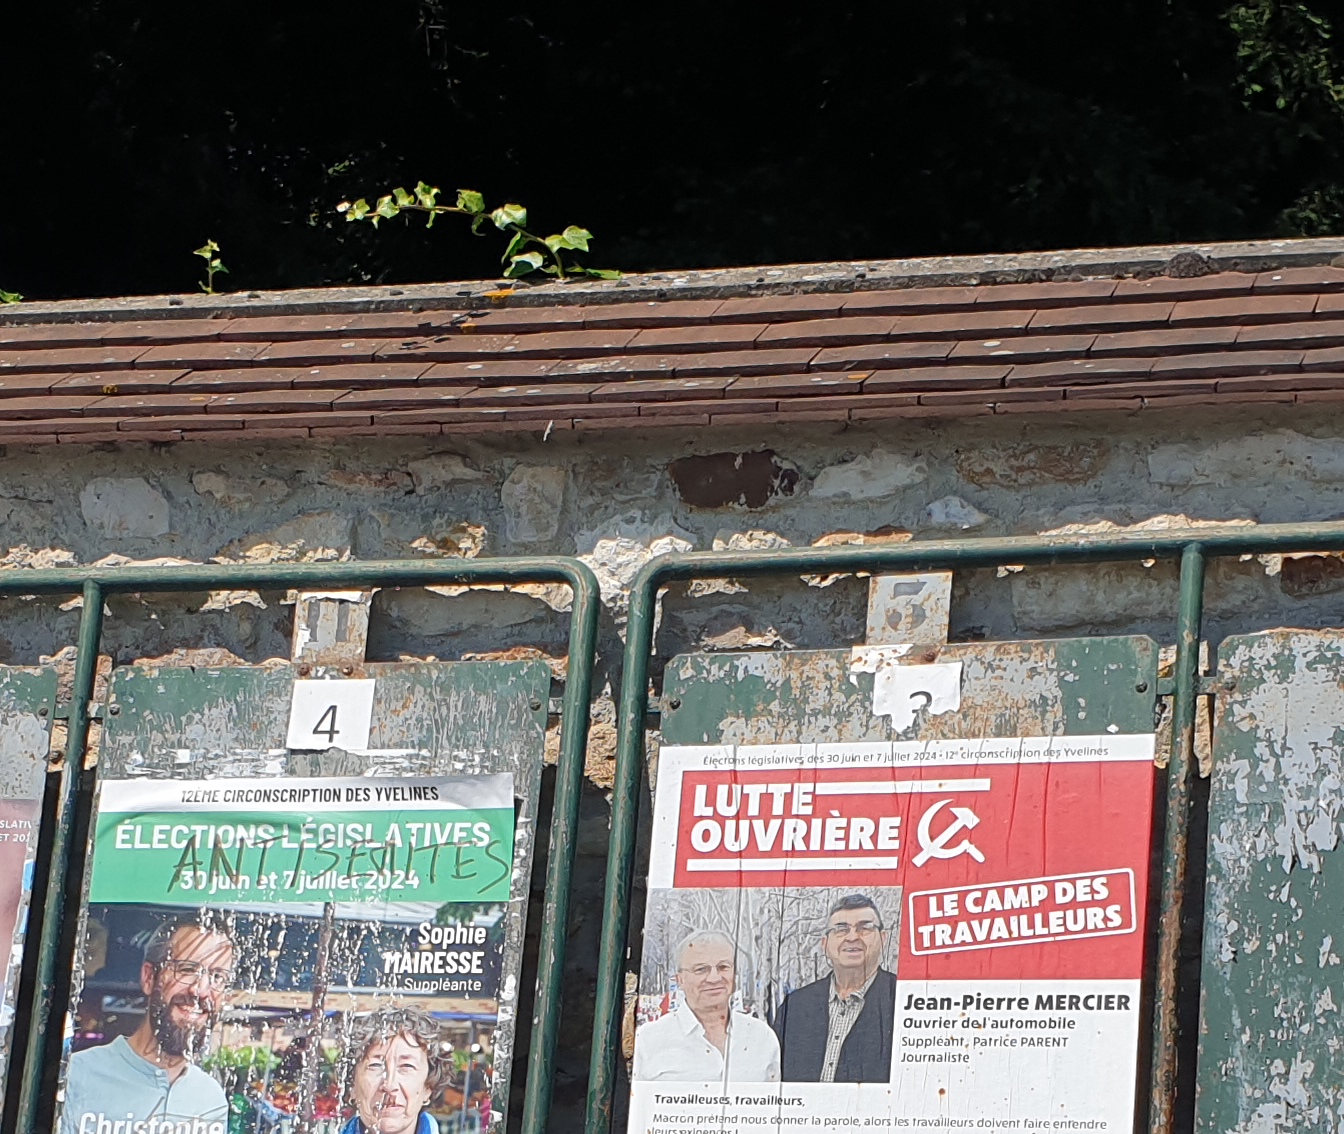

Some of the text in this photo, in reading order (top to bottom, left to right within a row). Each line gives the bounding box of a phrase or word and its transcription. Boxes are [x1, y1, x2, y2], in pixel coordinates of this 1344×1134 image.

[313, 704, 340, 743] 4
[913, 747, 1109, 761] 2024 circonscription Yvelines
[224, 786, 439, 803] CIRCONSCRIPTION DES YVELINES
[693, 783, 815, 817] LUTTE
[115, 817, 491, 849] ÉLECTIONS LÉGISLATIVES
[690, 810, 902, 852] OUVRIÈRE
[363, 869, 420, 890] 2024
[929, 877, 1109, 918] LE CAMP DES
[418, 922, 486, 949] Sophie
[918, 904, 1123, 948] TRAVAILLEURS
[384, 952, 484, 975] MAIRESSE
[404, 977, 482, 992] Suppléante
[904, 992, 1131, 1011] Jean-Pierre MERCIER
[903, 1017, 1076, 1029] Ouvrier l'automobile
[973, 1037, 1069, 1047] Patrice PARENT
[901, 1052, 970, 1063] Journaliste
[735, 1096, 805, 1107] travailleurs,
[653, 1114, 693, 1124] Macron
[741, 1116, 767, 1125] nous
[812, 1116, 821, 1126] la
[824, 1116, 862, 1130] parole,
[864, 1117, 891, 1127] alors
[894, 1117, 909, 1127] les
[913, 1117, 973, 1128] travailleurs
[977, 1118, 1020, 1128] doivent
[1053, 1119, 1107, 1129] entendre
